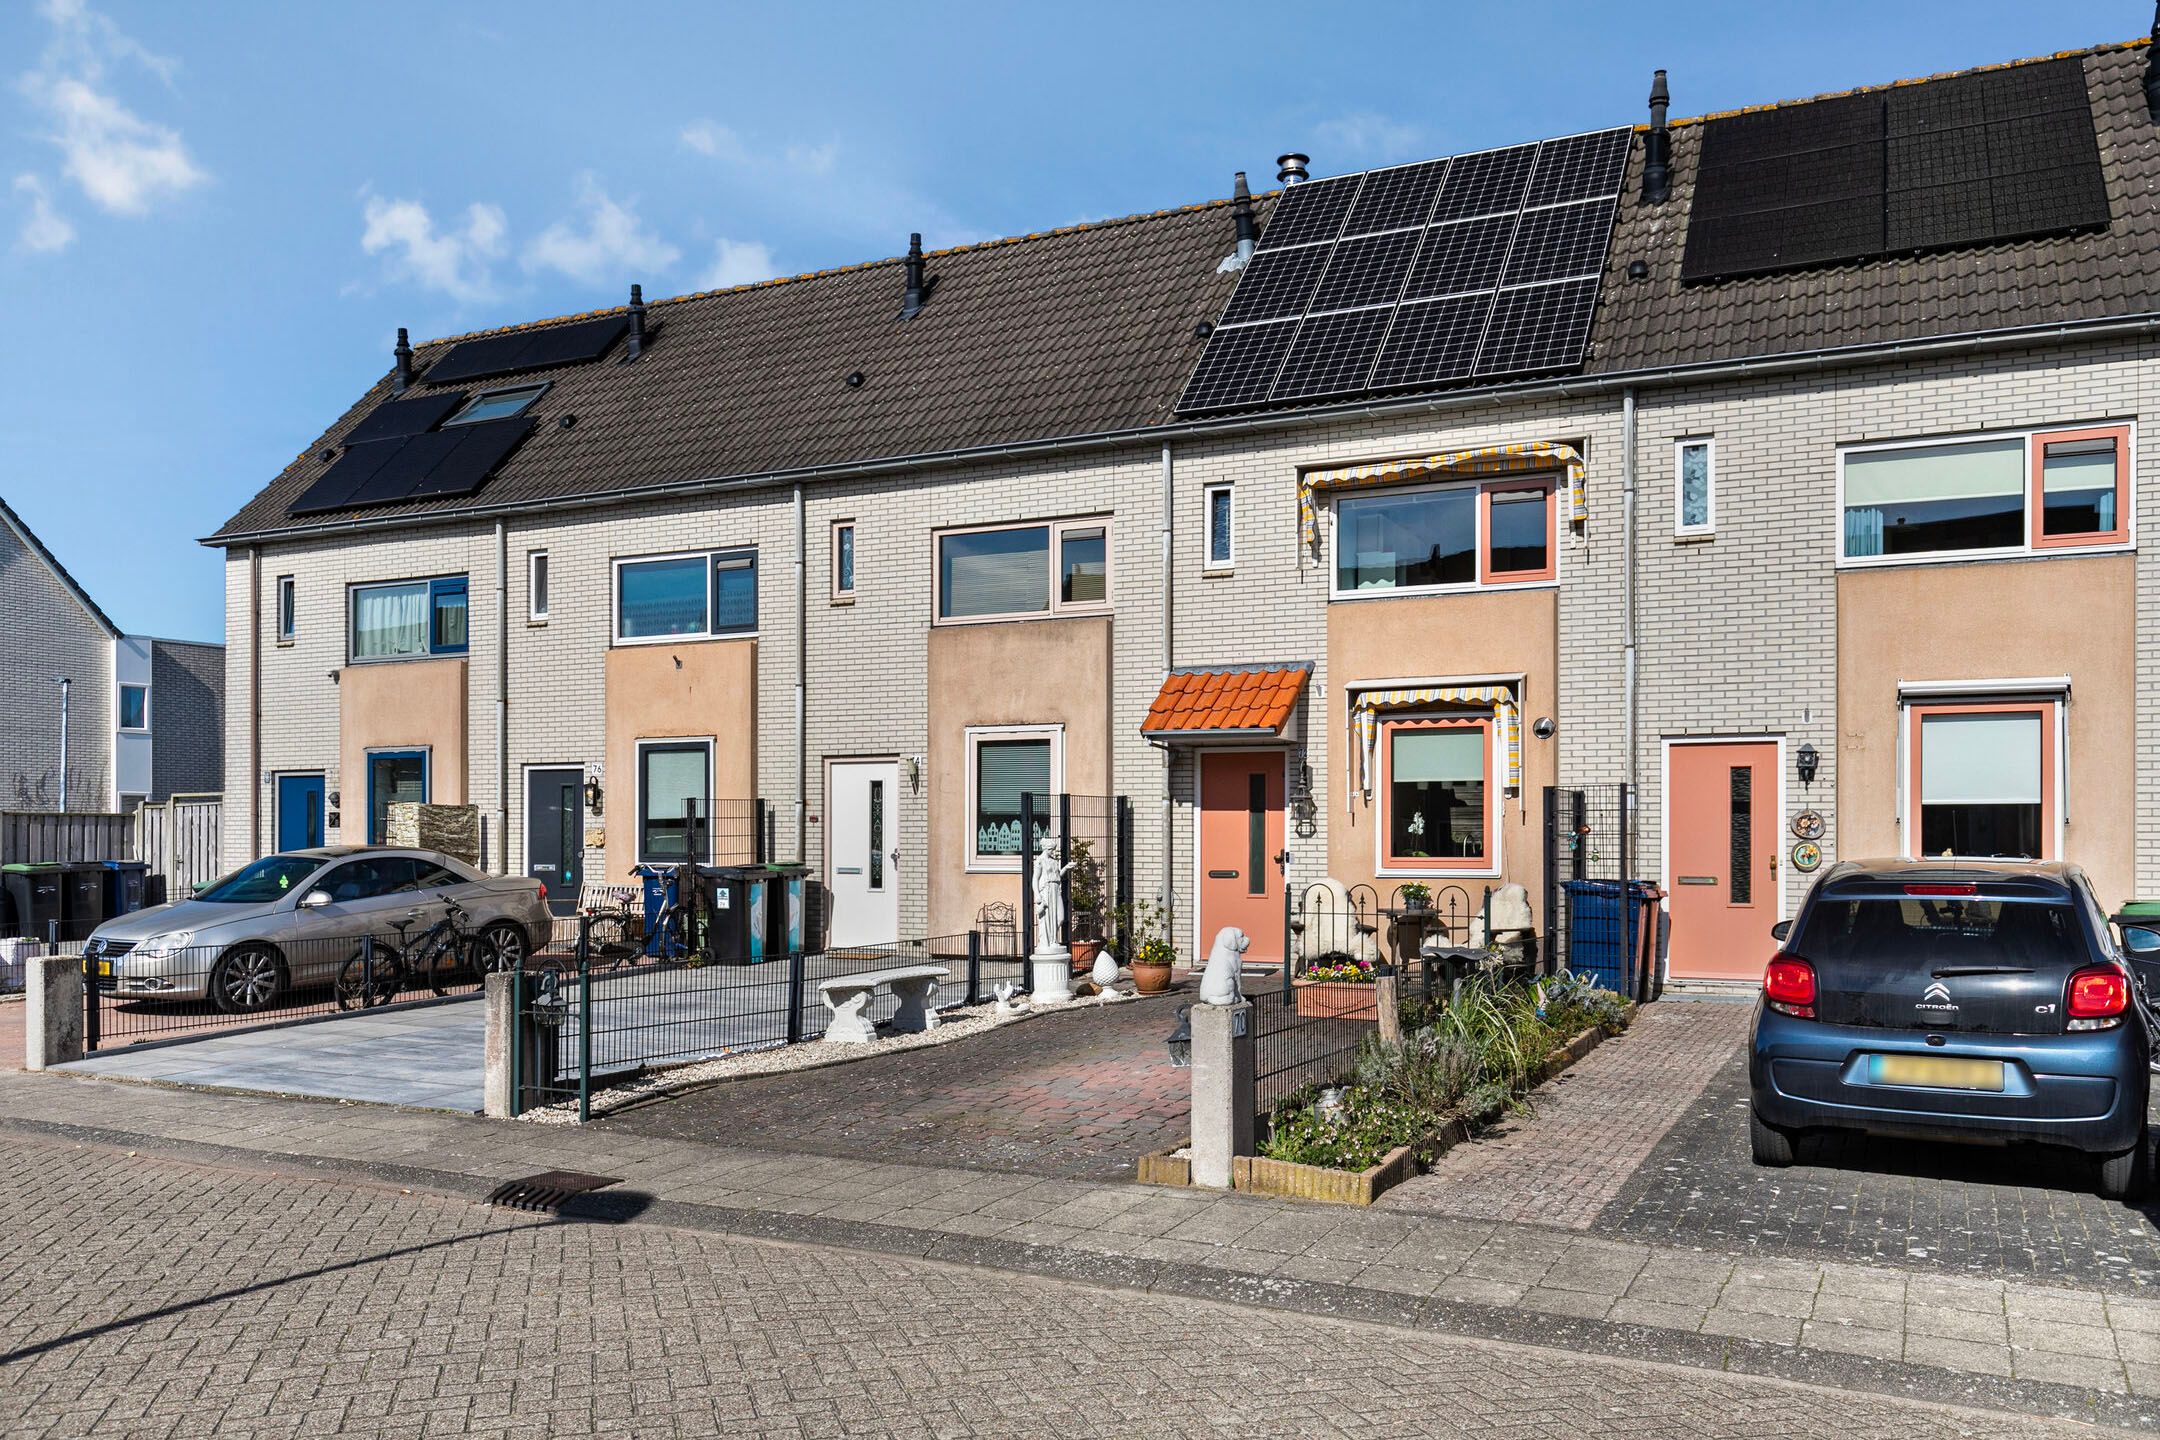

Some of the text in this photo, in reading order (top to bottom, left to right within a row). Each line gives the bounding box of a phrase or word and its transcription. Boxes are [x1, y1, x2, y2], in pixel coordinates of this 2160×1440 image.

[593, 764, 602, 773] 76
[2035, 1003, 2056, 1014] C1
[1233, 1010, 1246, 1034] 70
